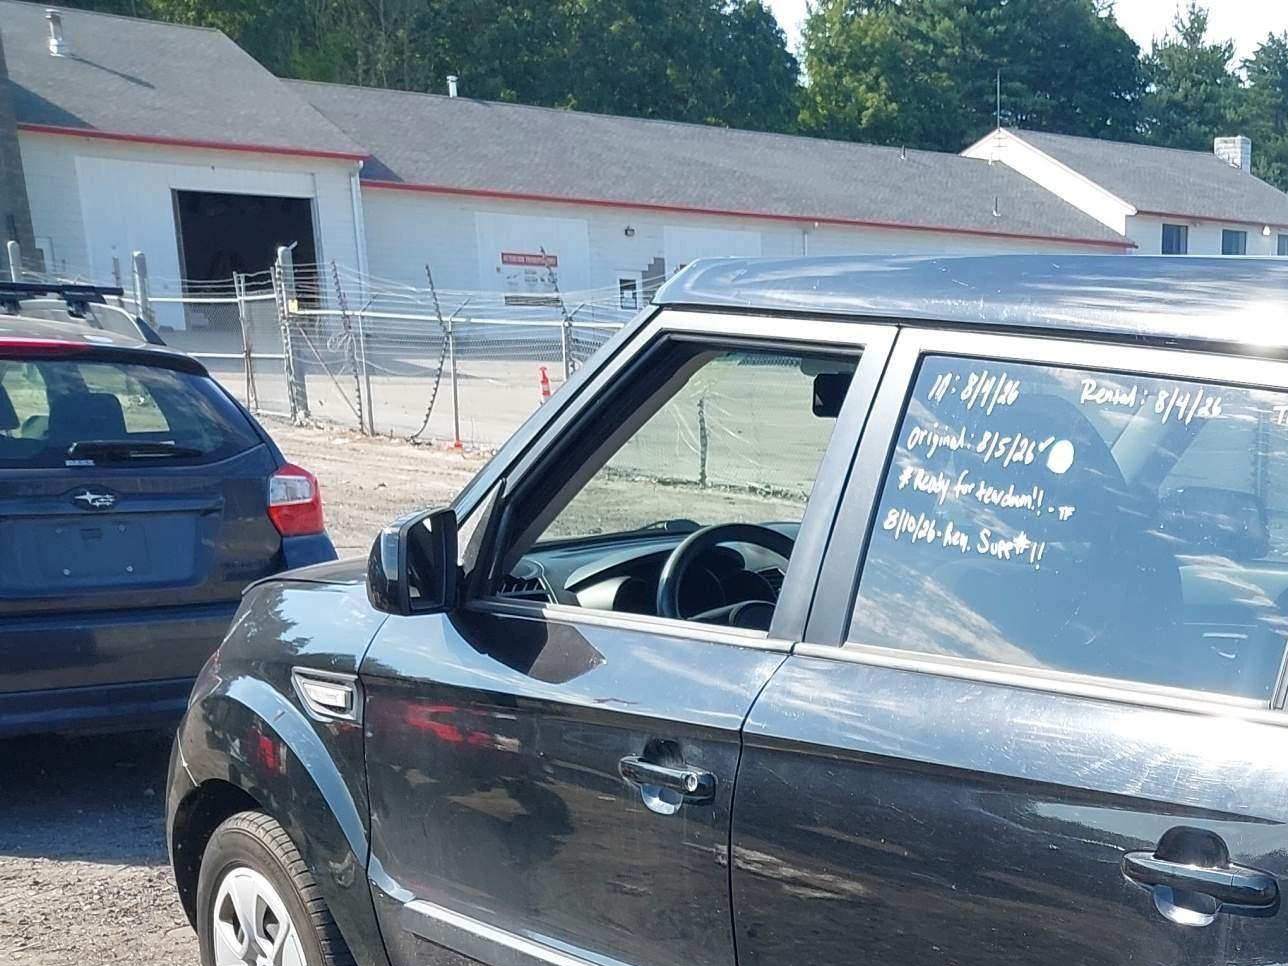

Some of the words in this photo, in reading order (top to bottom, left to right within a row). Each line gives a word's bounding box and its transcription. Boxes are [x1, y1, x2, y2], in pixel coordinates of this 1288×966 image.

[1154, 387, 1223, 425] 8/4/26
[976, 431, 1036, 468] 8/5/26
[953, 469, 975, 499] for
